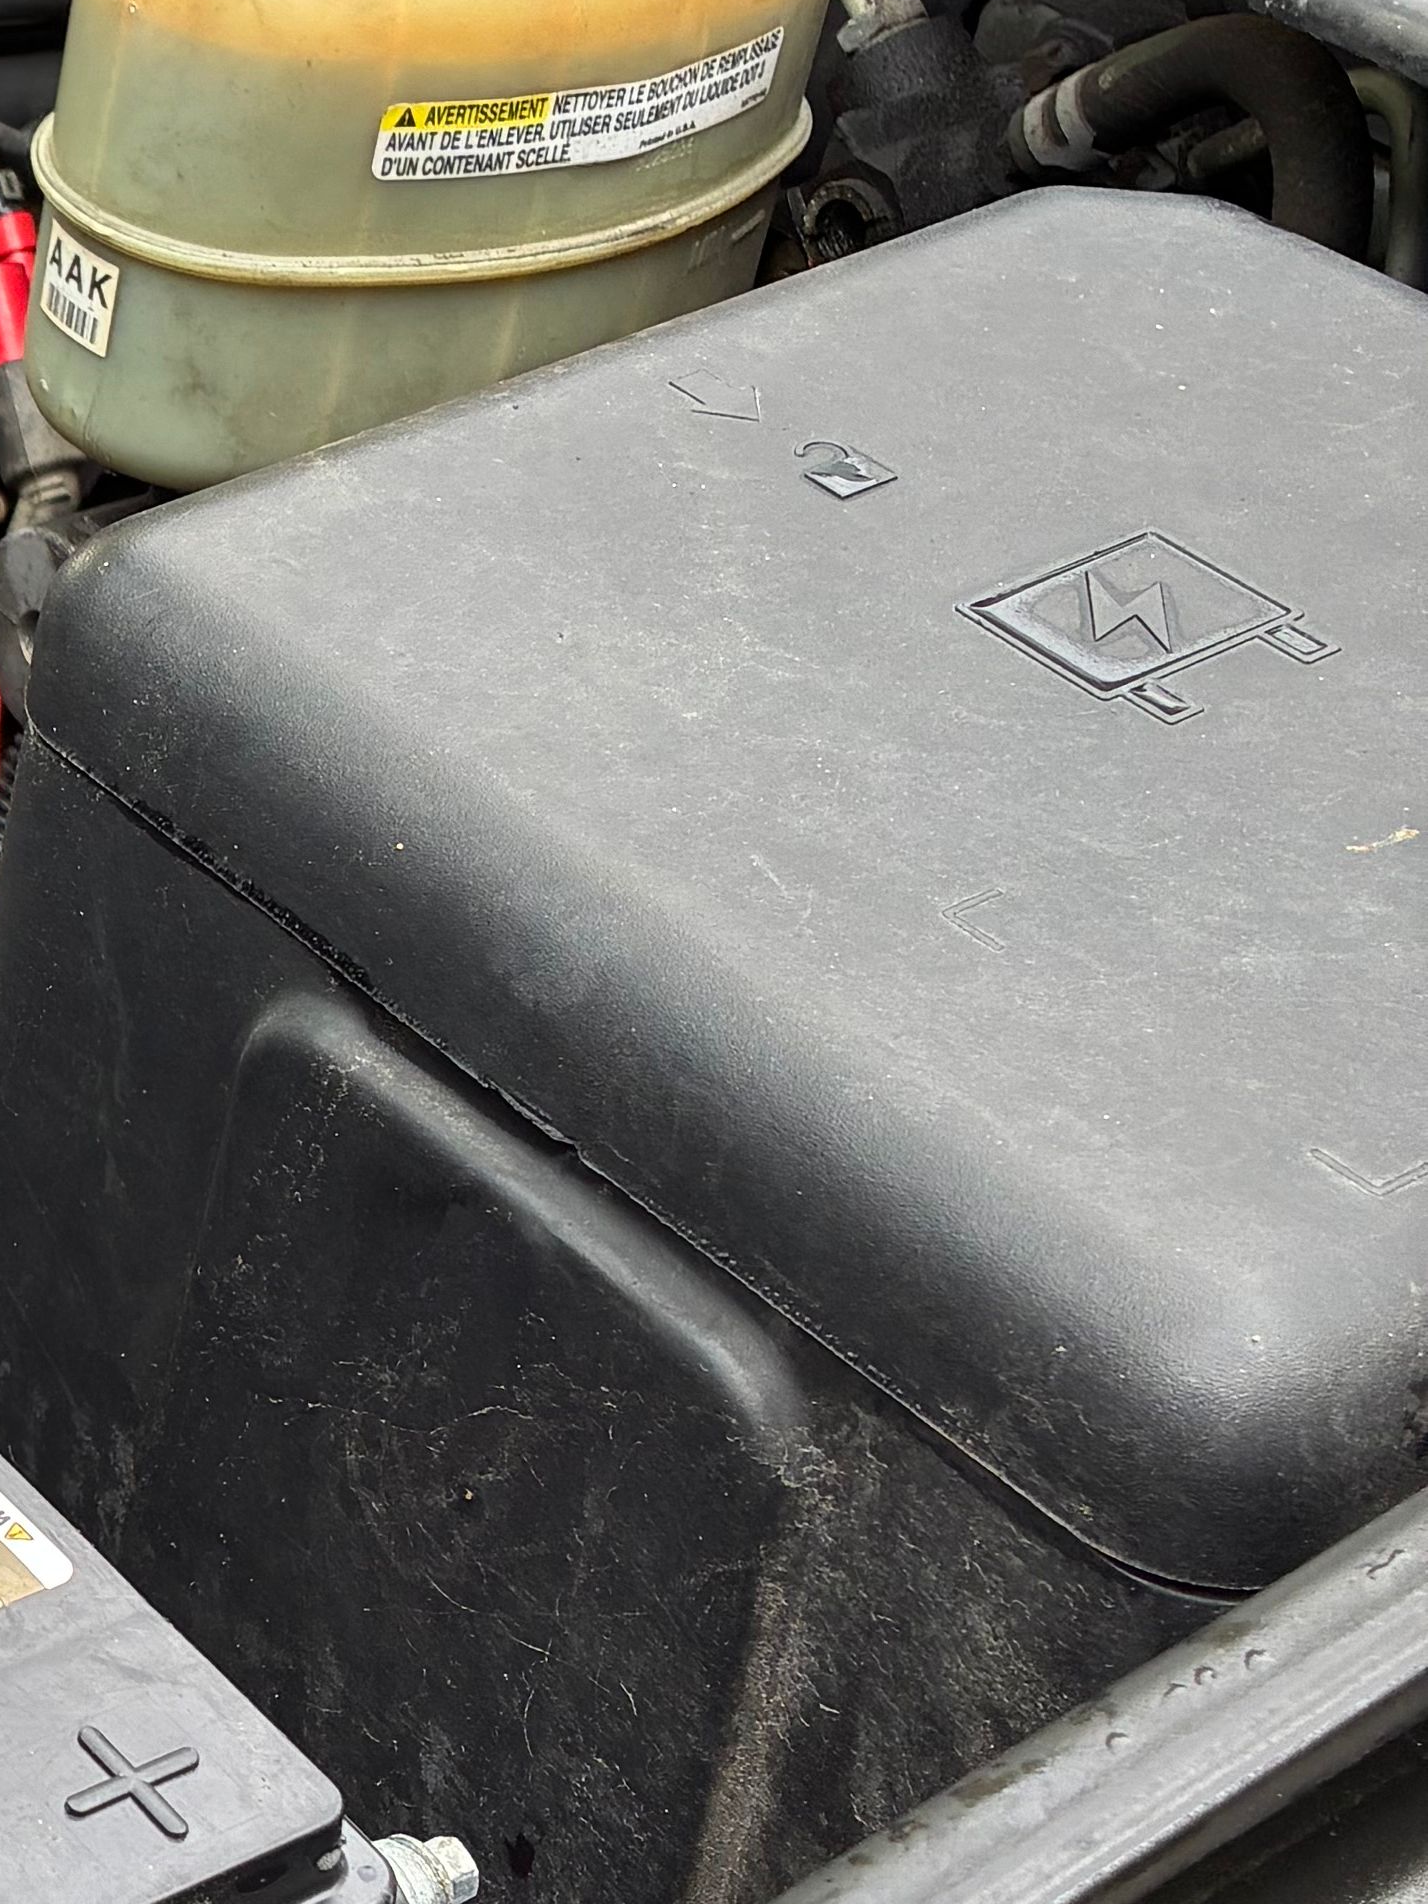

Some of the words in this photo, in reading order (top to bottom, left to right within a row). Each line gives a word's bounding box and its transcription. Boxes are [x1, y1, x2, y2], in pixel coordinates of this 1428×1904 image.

[385, 130, 438, 152] AVANT
[440, 130, 461, 151] DE
[465, 122, 545, 150] L'ENLEVER.
[549, 114, 612, 141] UTILISER
[613, 94, 681, 132] SEULEMENT
[682, 88, 697, 111] DU
[424, 97, 549, 127] AVERTISSEMENT
[552, 88, 626, 116] NETTOYER
[628, 83, 647, 106] LE
[647, 63, 700, 103] BOUCHON
[700, 58, 717, 82] DE
[381, 156, 419, 177] D'UN
[422, 150, 515, 176] CONTENANT
[49, 237, 113, 309] AAK
